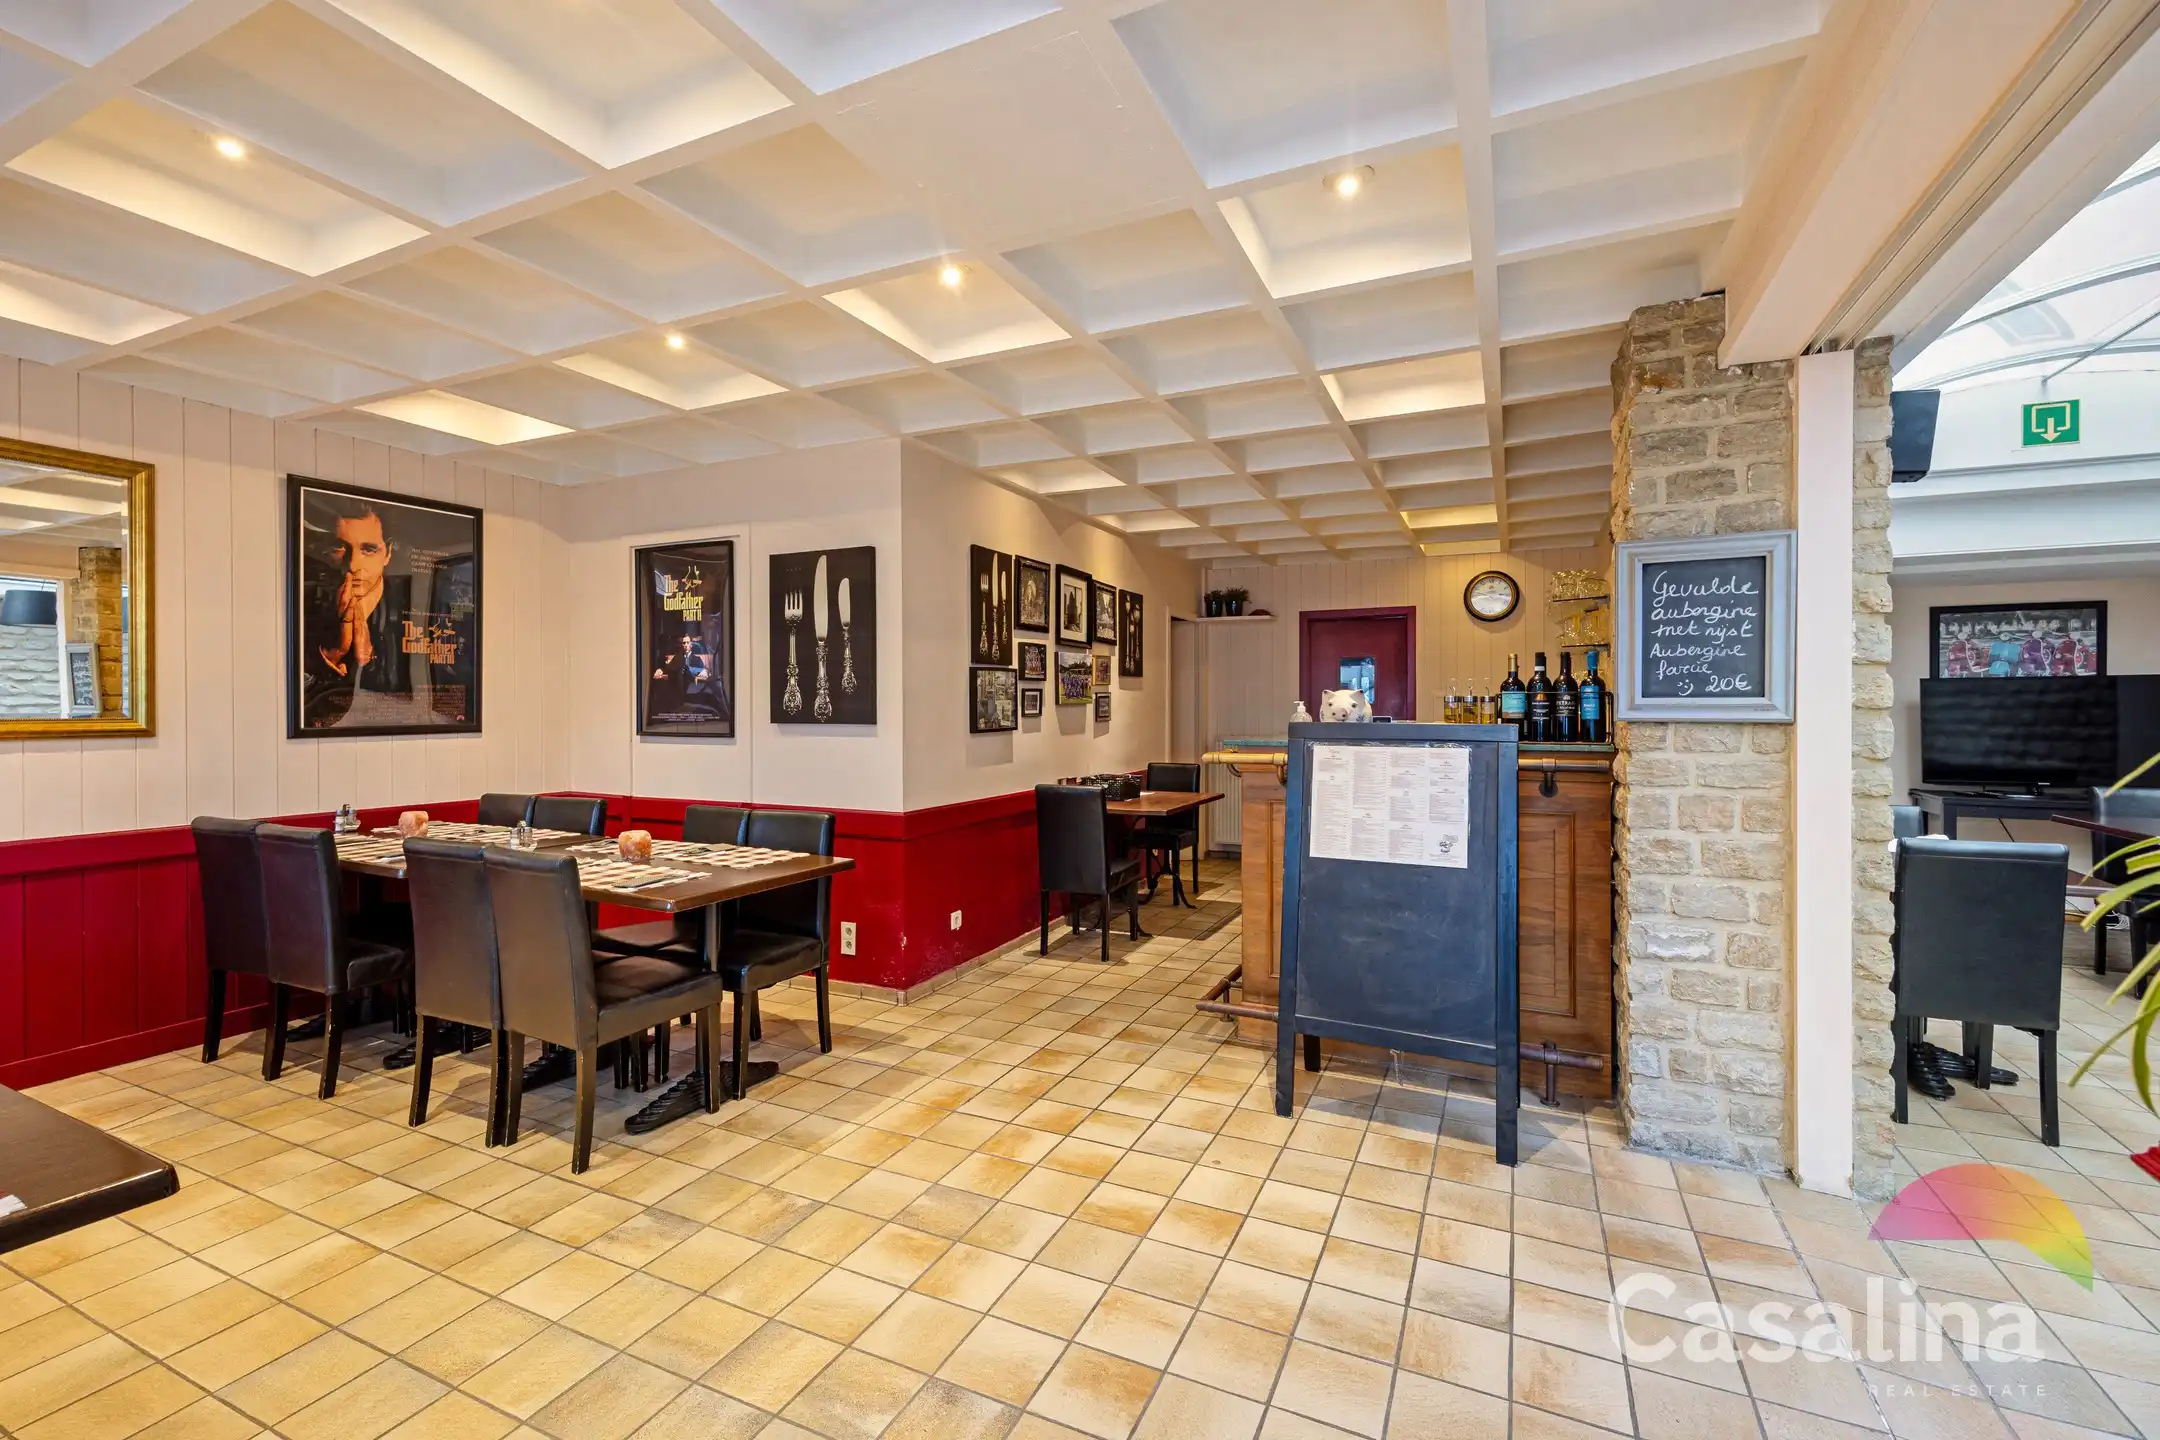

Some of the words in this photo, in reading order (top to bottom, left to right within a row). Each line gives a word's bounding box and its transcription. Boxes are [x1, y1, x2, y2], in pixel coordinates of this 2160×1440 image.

[664, 574, 679, 593] The
[1652, 570, 1759, 607] Gevulde
[664, 591, 704, 611] Godfather
[401, 620, 424, 638] The
[1650, 619, 1701, 638] met
[402, 636, 457, 656] Godfather
[1649, 642, 1747, 662] Aubergine
[1656, 659, 1713, 681] farcie
